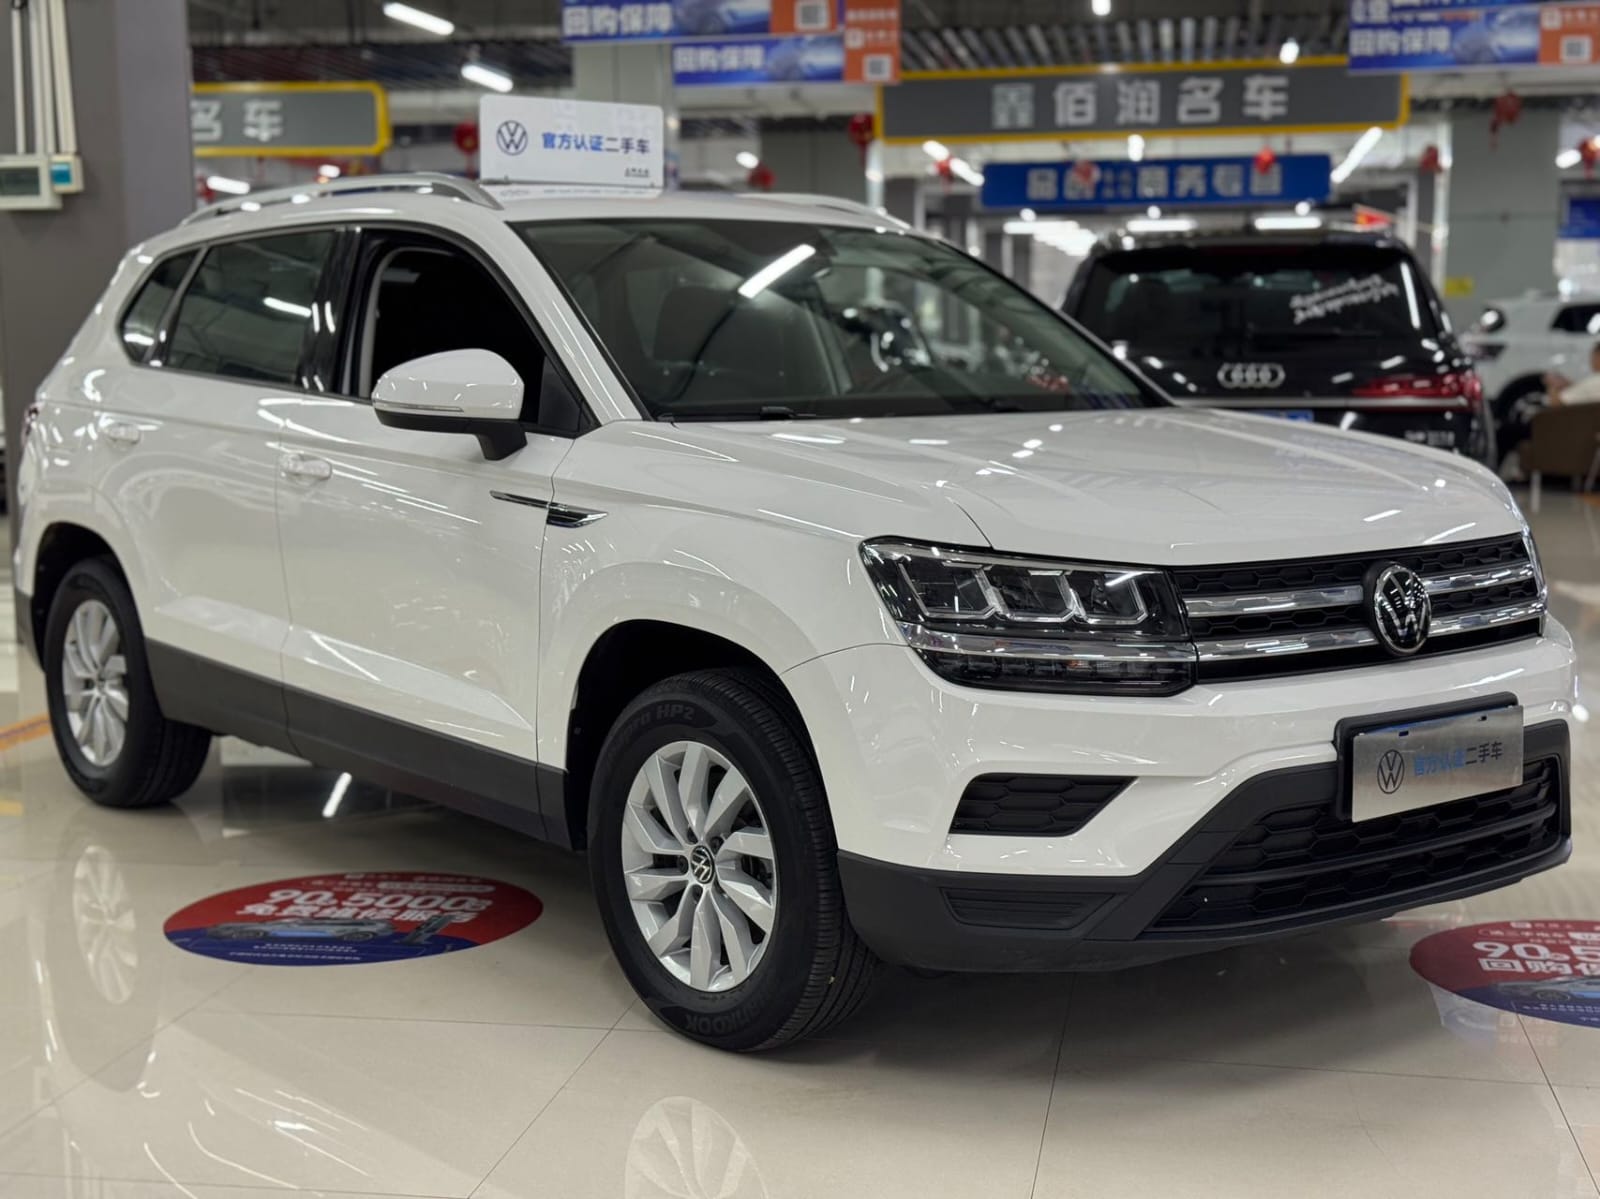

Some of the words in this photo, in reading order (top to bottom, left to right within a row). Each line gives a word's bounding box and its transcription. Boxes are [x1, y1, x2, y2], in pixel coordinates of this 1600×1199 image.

[542, 131, 651, 155] 官方认证二手车
[1414, 741, 1503, 777] 官方认证二手车
